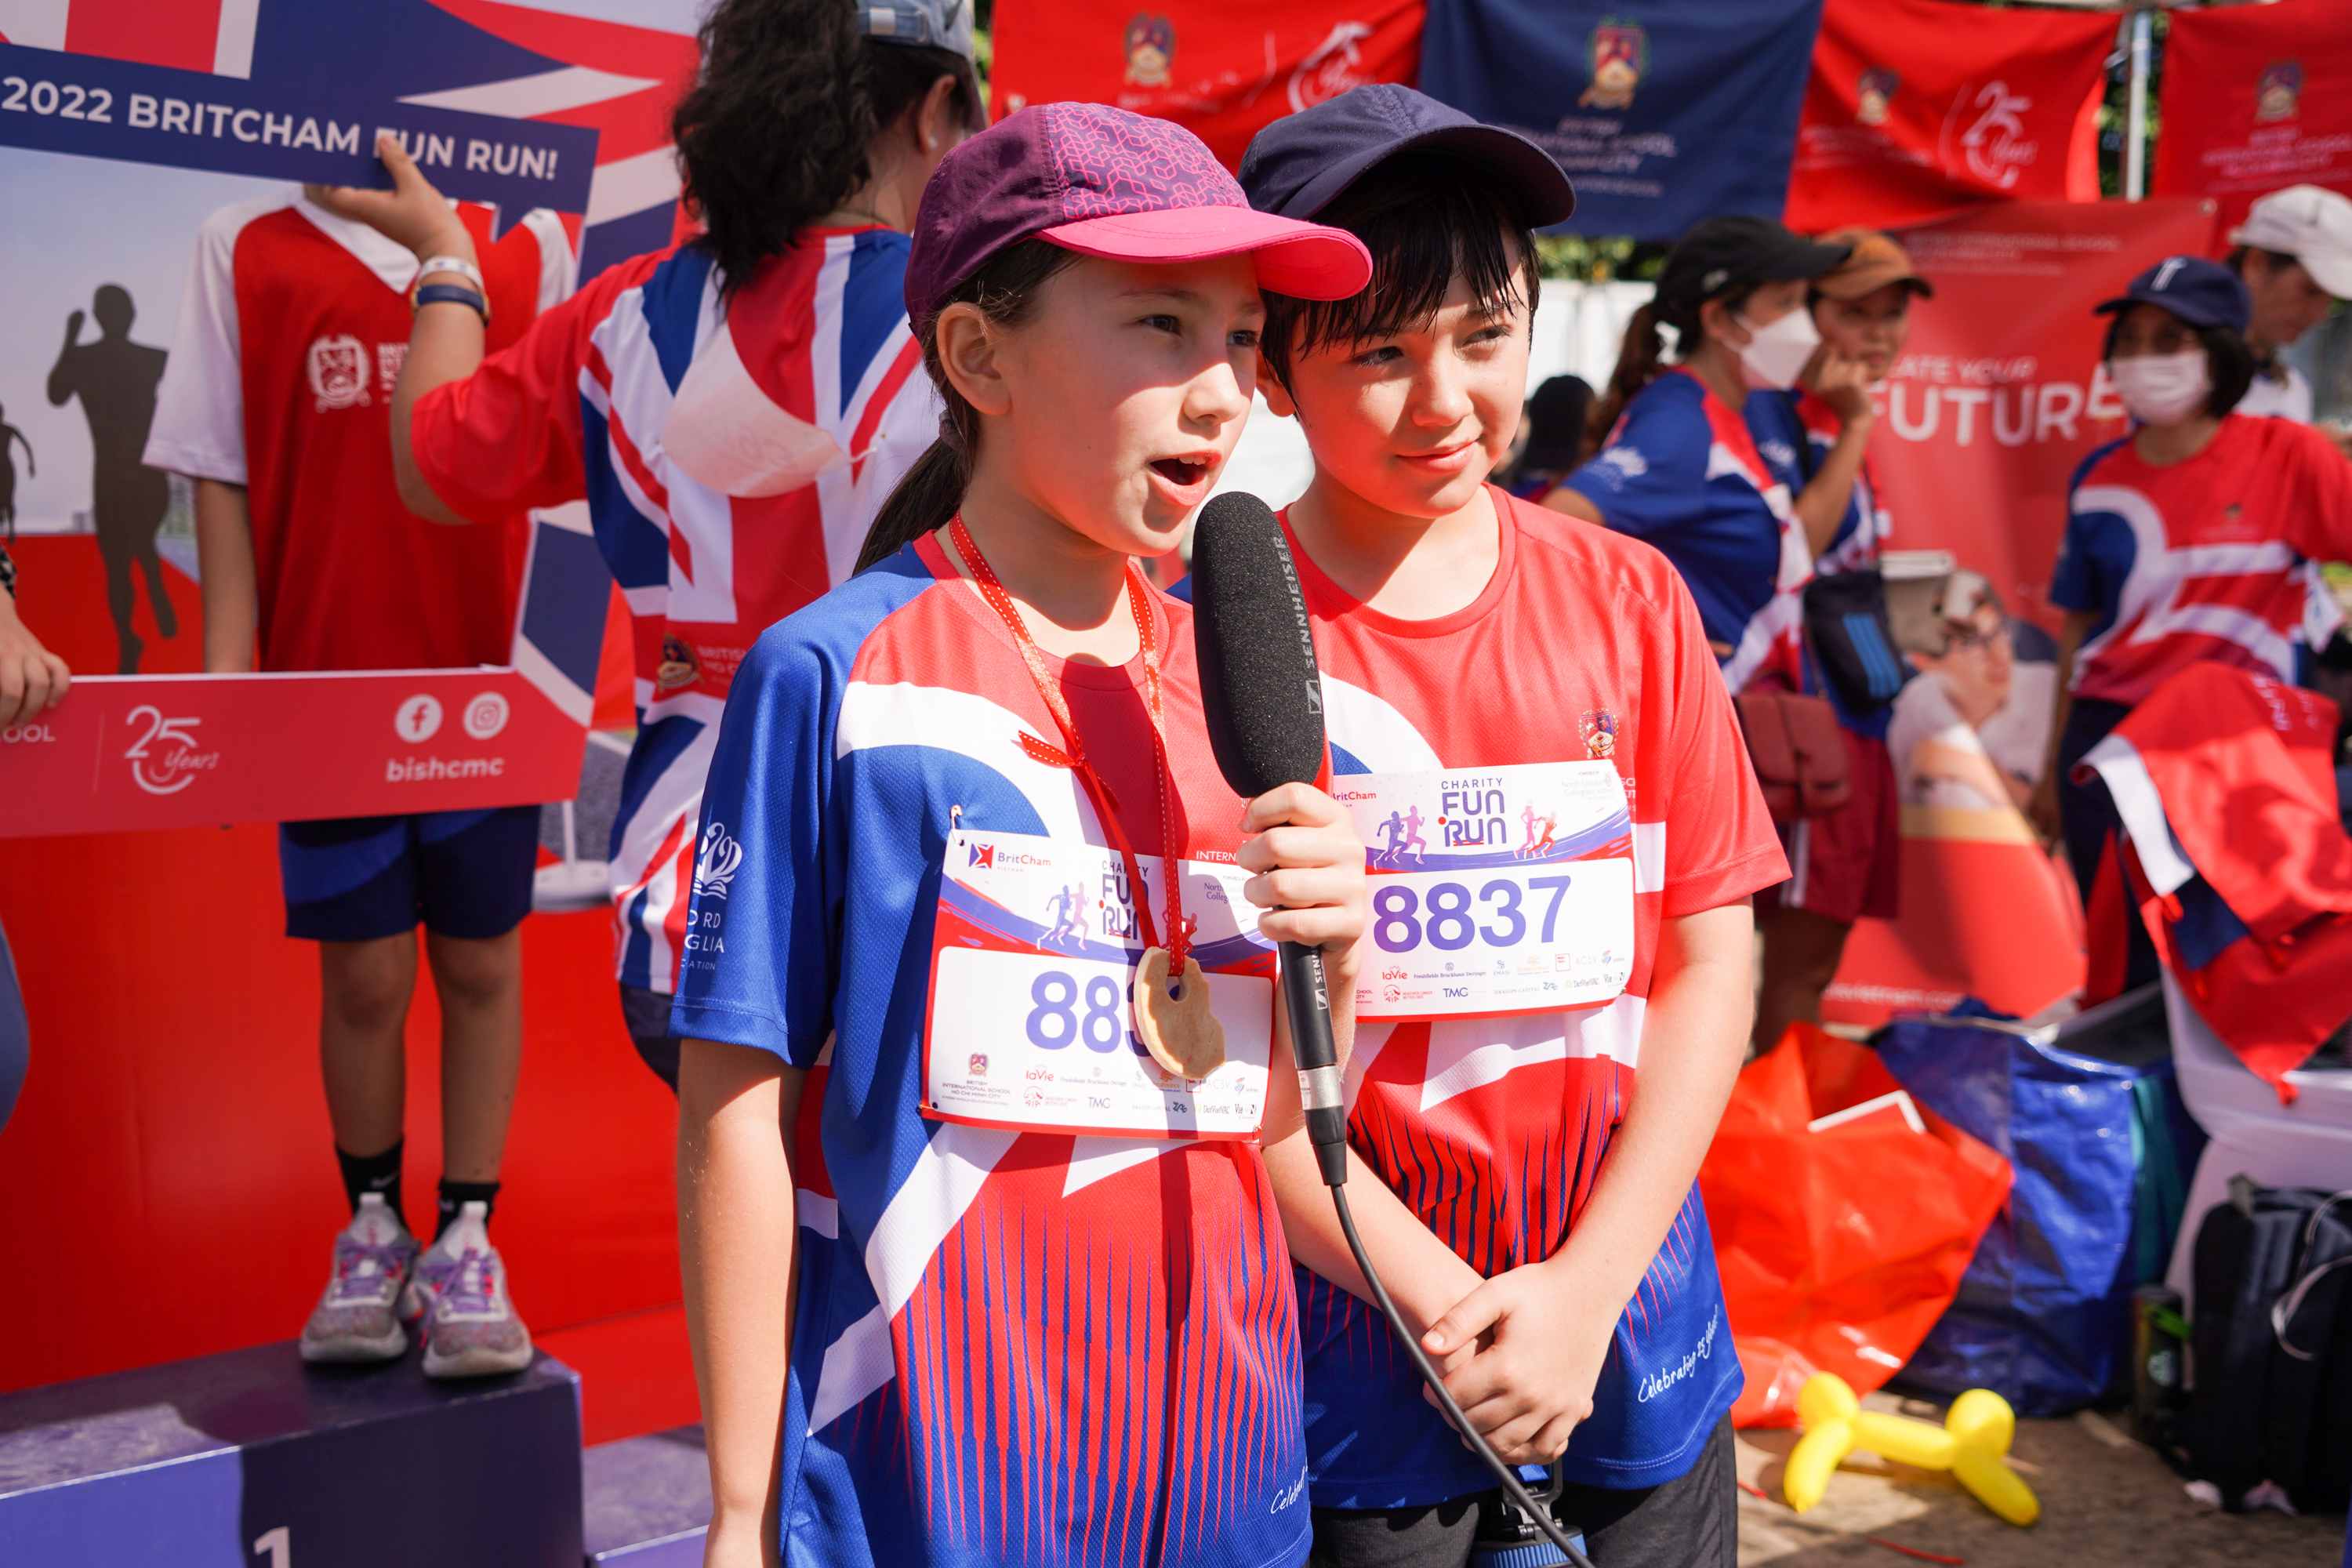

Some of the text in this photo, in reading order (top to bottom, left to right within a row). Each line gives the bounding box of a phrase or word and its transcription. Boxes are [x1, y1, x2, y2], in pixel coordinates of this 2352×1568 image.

[1, 76, 113, 124] 2022
[127, 93, 361, 156] BRITCHAM
[465, 137, 559, 181] RUN!
[1888, 355, 2038, 383] ATE YOUR
[1273, 536, 1315, 669] SENNHEISER
[125, 704, 201, 795] 25
[387, 755, 506, 782] bishcmc
[1333, 791, 1377, 801] ritCham
[1440, 777, 1504, 790] CHARITY
[1441, 789, 1505, 816] FUN
[1444, 816, 1507, 848] RUN
[997, 851, 1052, 866] BritCham
[1102, 860, 1149, 877] CHAY
[1373, 874, 1571, 953] 8837
[1443, 987, 1468, 998] TMG
[1025, 1069, 1054, 1082] laVie
[1638, 1351, 1697, 1403] Celebrating
[253, 1526, 292, 1568] 1
